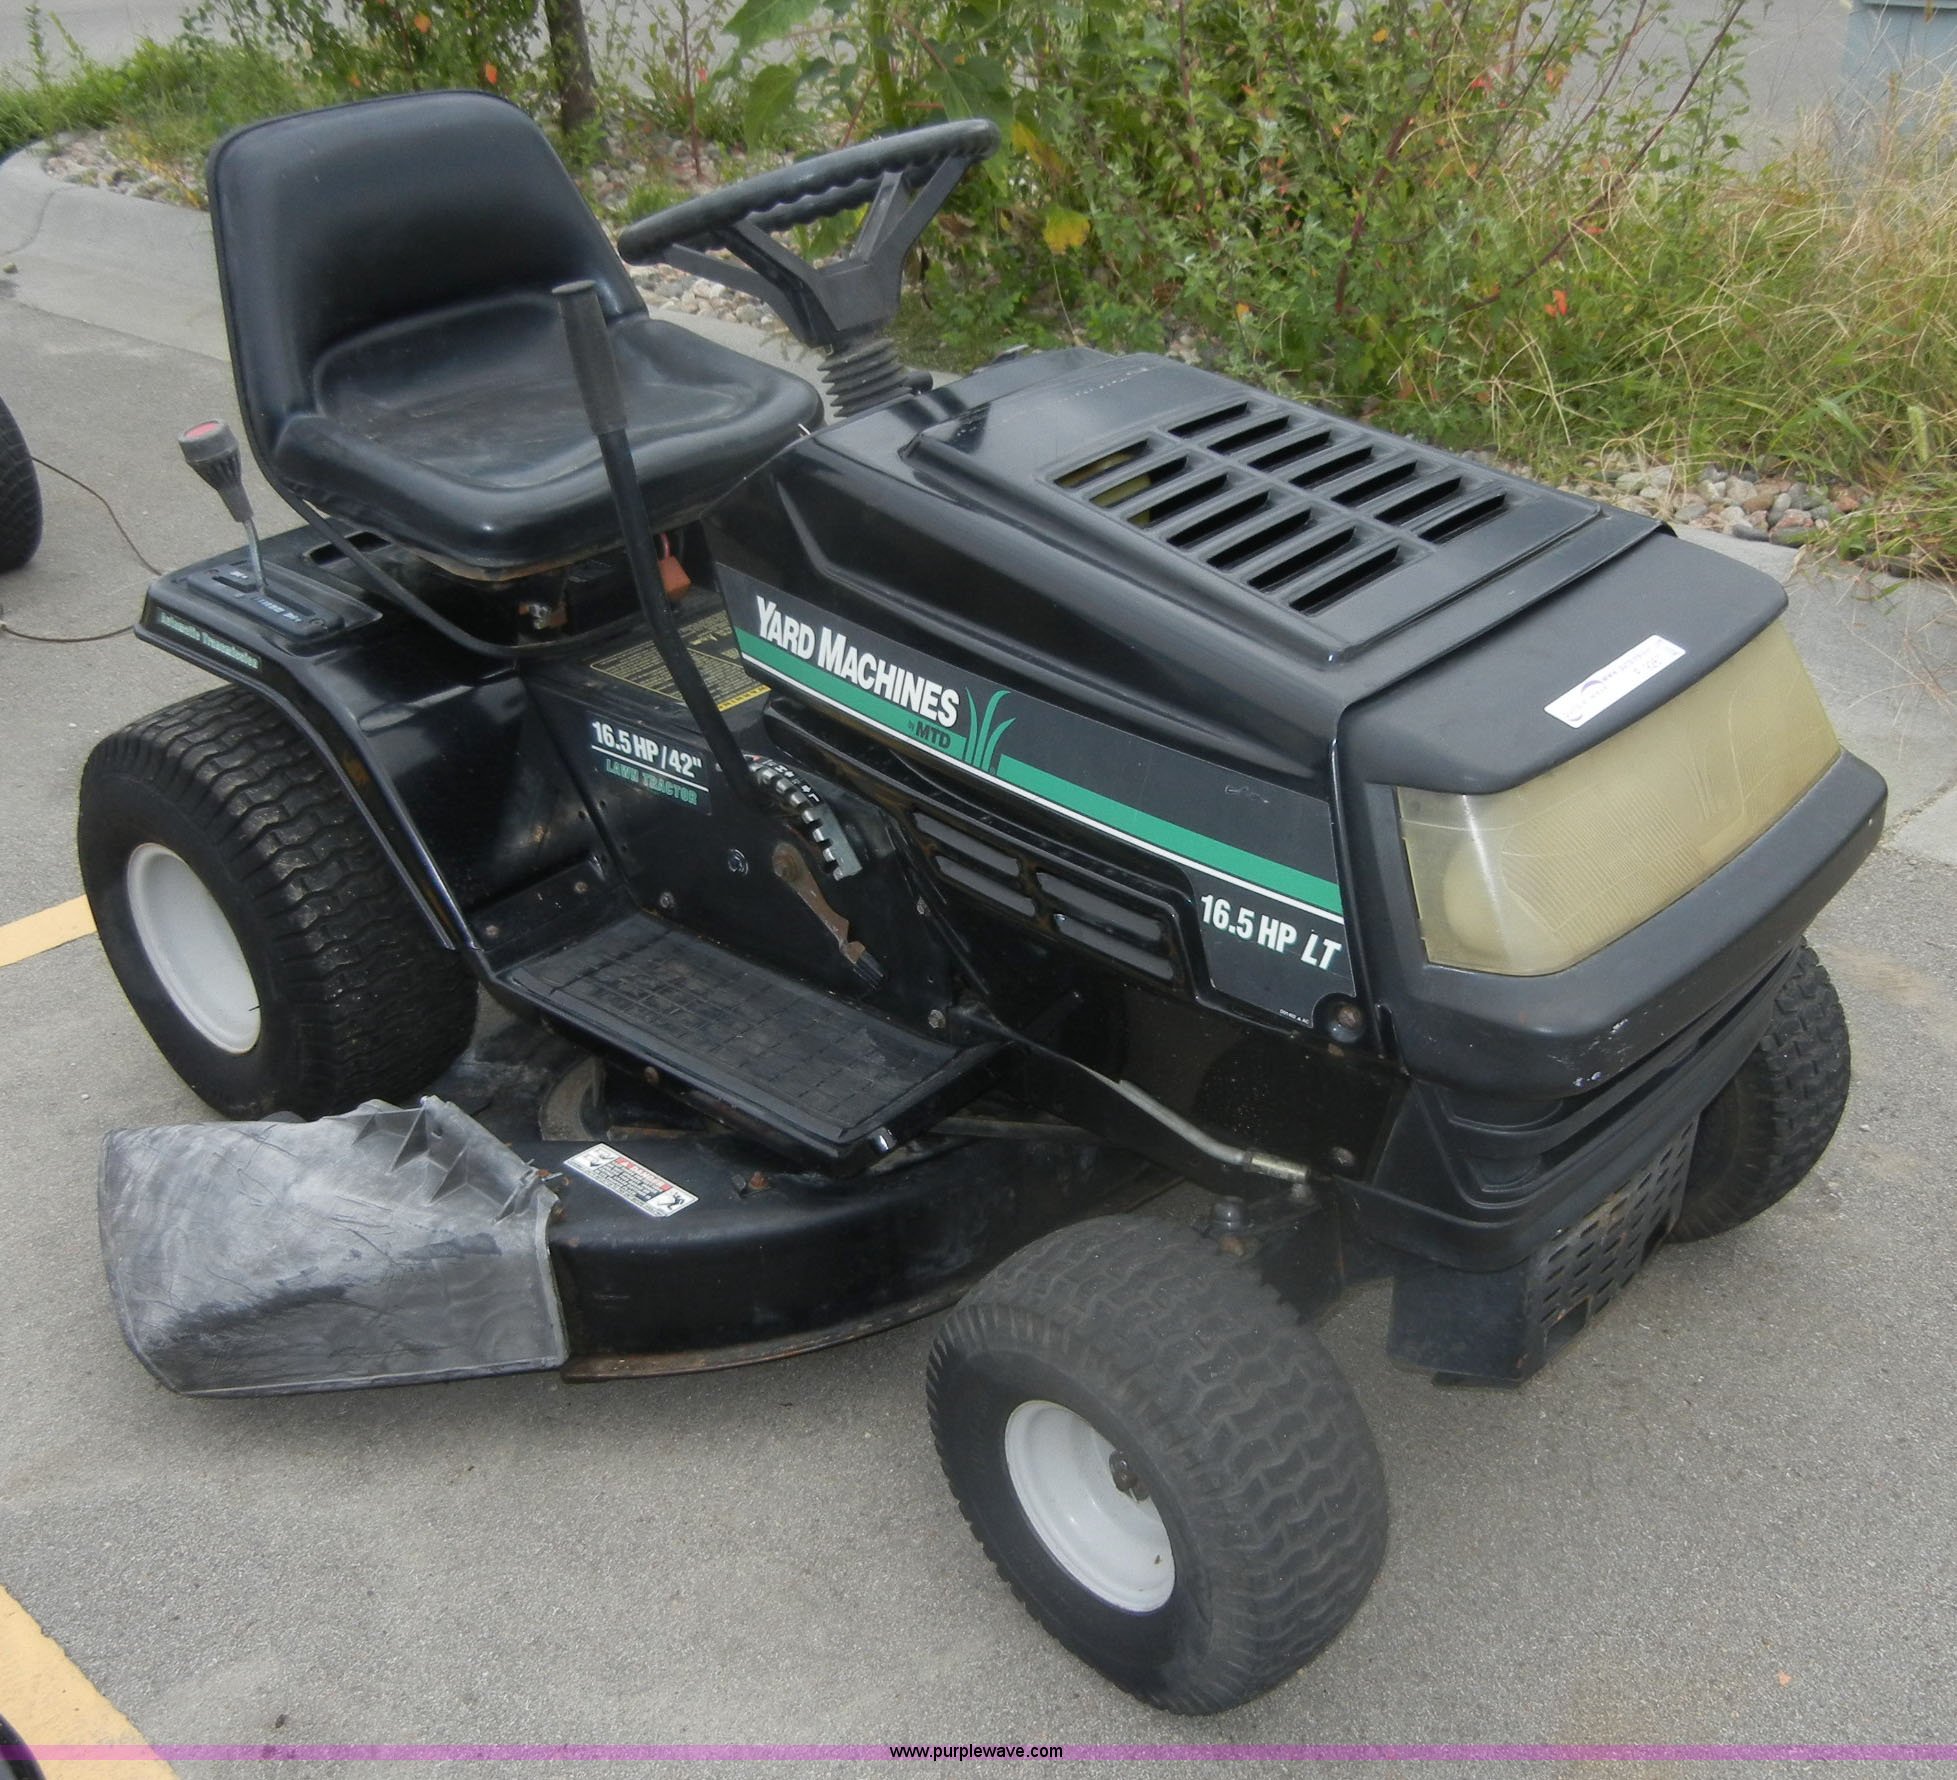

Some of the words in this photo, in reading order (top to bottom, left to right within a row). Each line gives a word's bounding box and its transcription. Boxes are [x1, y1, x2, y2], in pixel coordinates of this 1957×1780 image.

[756, 595, 816, 660] YARD
[817, 625, 960, 728] MACHINES
[592, 721, 632, 754] 16.5
[632, 734, 660, 763] HP
[916, 721, 951, 749] MTD
[606, 758, 639, 783] LAWN
[642, 771, 698, 806] TRACTOR
[1201, 894, 1255, 940] 16.5
[1257, 914, 1298, 954] HP
[1301, 933, 1343, 970] LT
